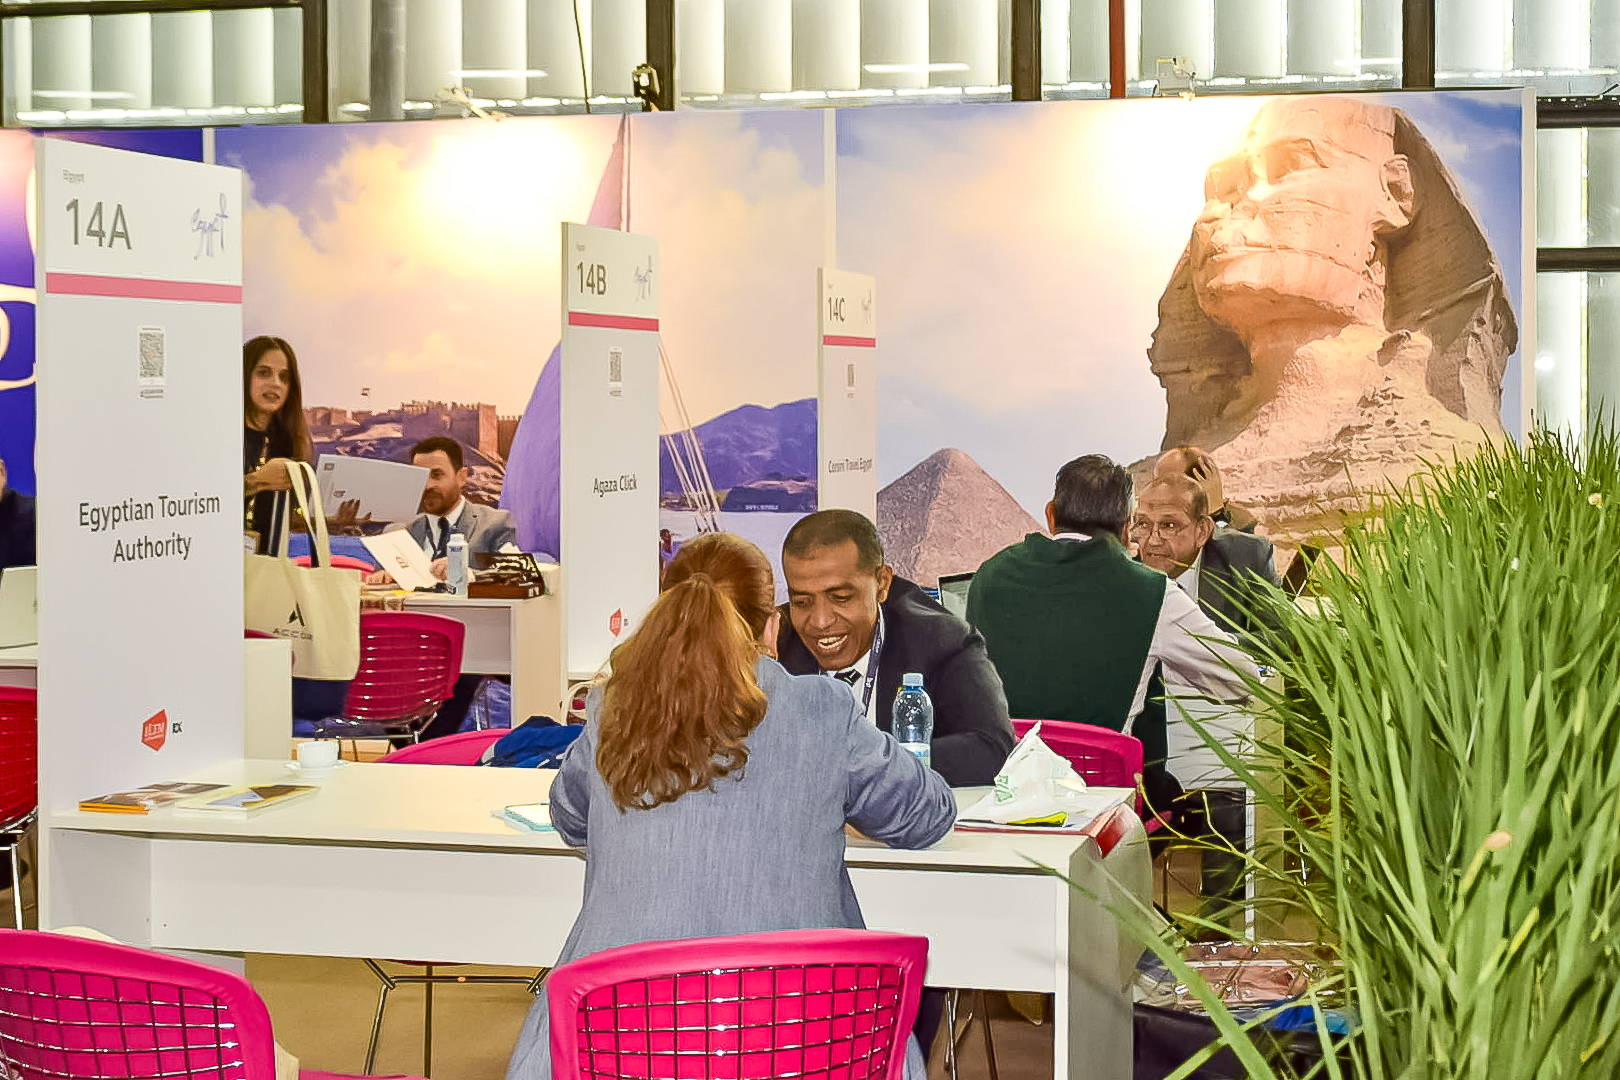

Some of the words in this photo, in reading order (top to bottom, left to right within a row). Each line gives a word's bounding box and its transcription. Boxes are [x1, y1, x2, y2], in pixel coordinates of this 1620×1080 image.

[66, 198, 132, 250] 14A
[577, 261, 606, 295] 14B
[828, 296, 846, 322] 14C
[593, 477, 618, 498] Agaza
[619, 473, 638, 491] Click
[79, 498, 154, 532] Egyptian
[158, 492, 220, 518] Tourism
[113, 531, 192, 563] Authority
